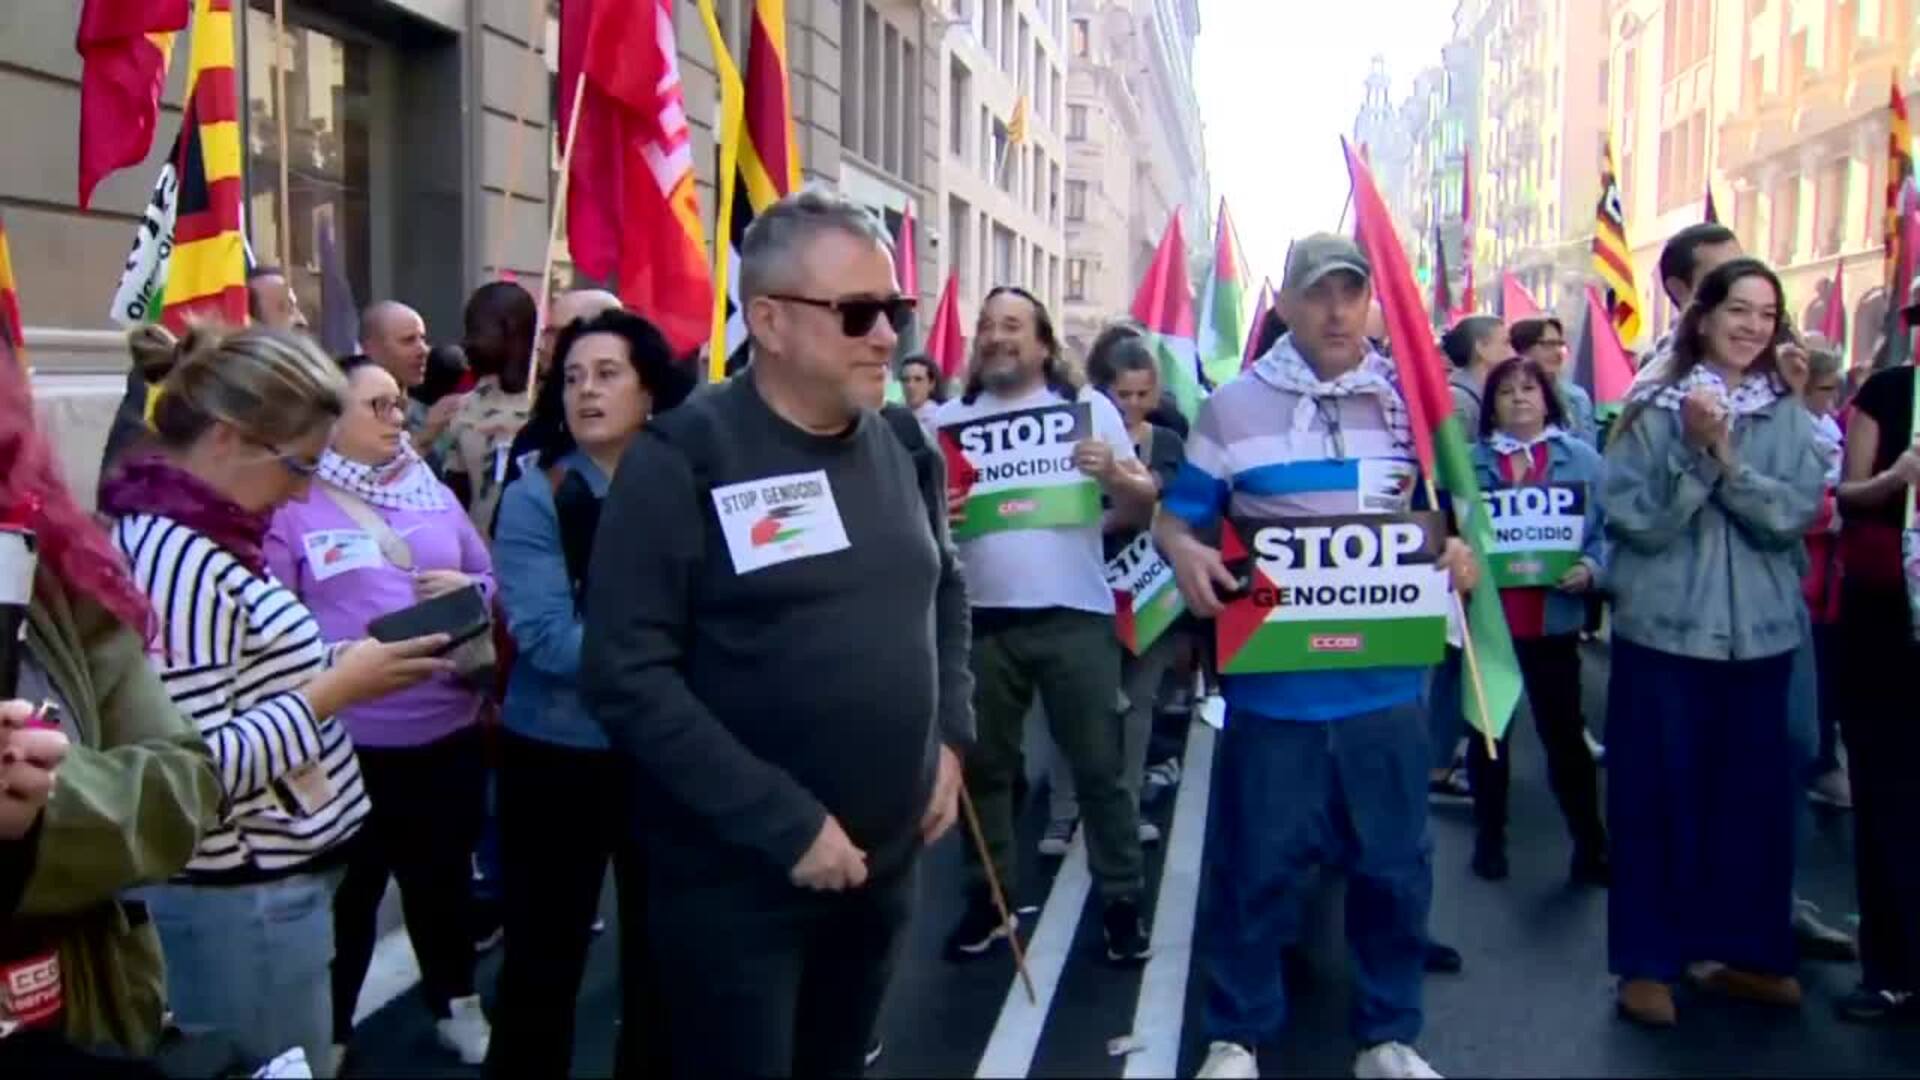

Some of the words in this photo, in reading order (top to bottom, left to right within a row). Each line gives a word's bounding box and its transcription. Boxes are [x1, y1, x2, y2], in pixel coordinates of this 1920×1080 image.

[959, 412, 1075, 453] STOP
[721, 489, 757, 515] STOP
[1253, 523, 1424, 570] STOP
[1496, 525, 1573, 542] NOCIDIO
[1251, 583, 1421, 608] GENOCIDIO
